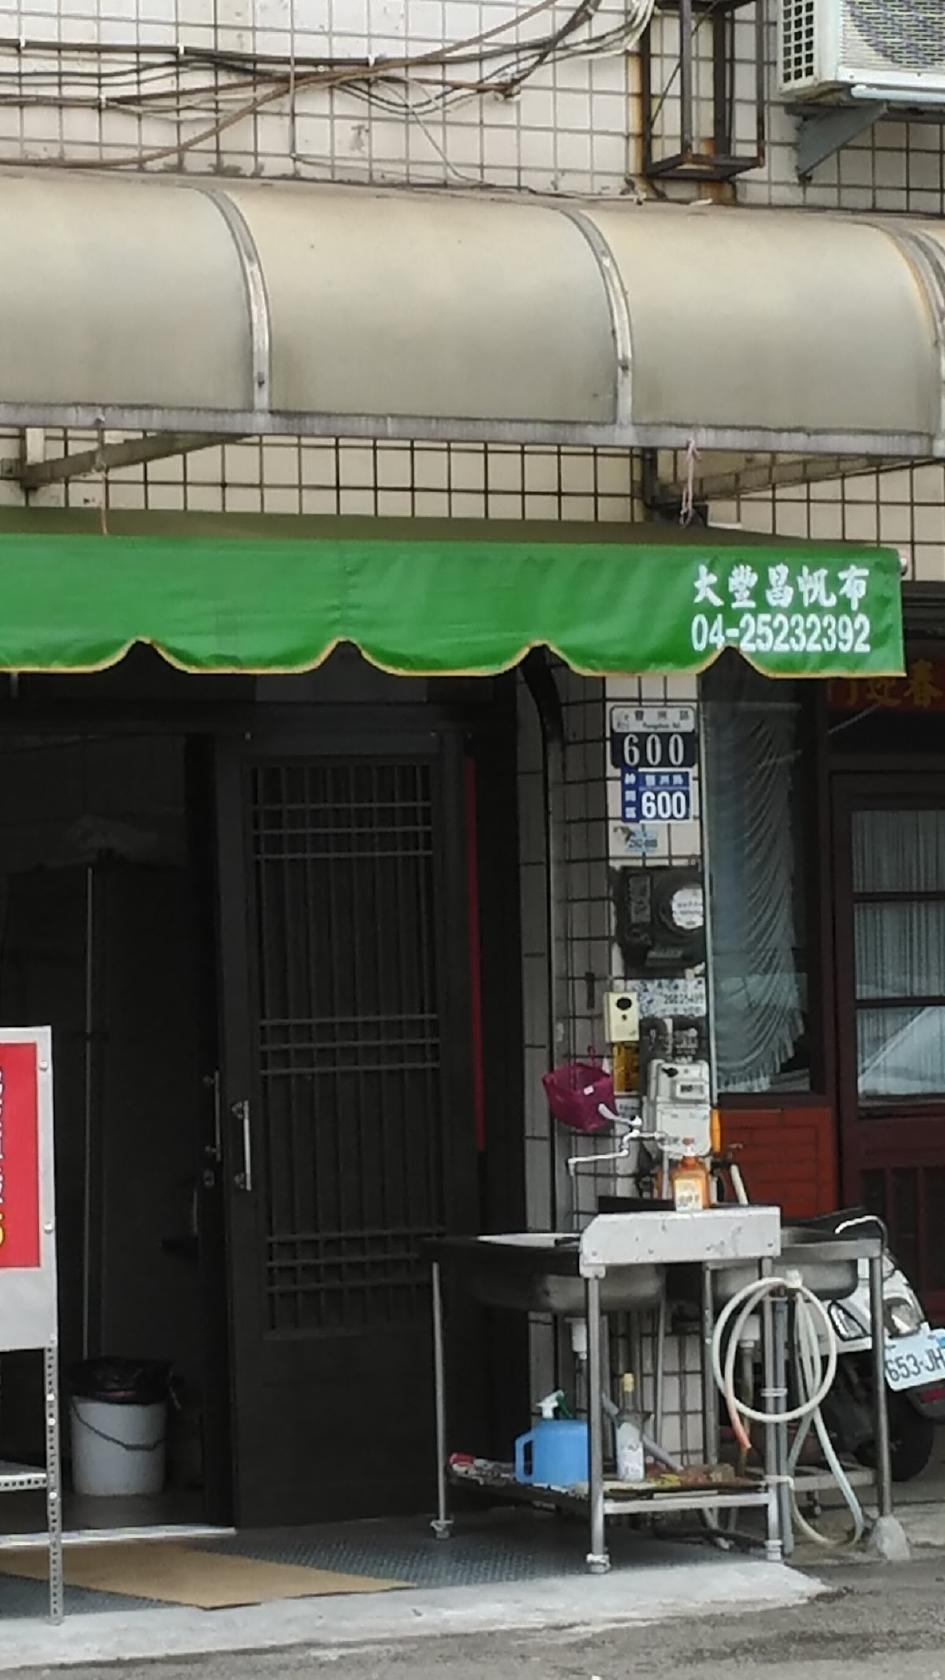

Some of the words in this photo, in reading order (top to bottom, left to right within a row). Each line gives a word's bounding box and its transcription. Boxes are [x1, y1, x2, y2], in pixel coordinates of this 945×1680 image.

[691, 613, 870, 652] 04-25232392
[623, 733, 685, 767] 600
[641, 791, 687, 819] 600
